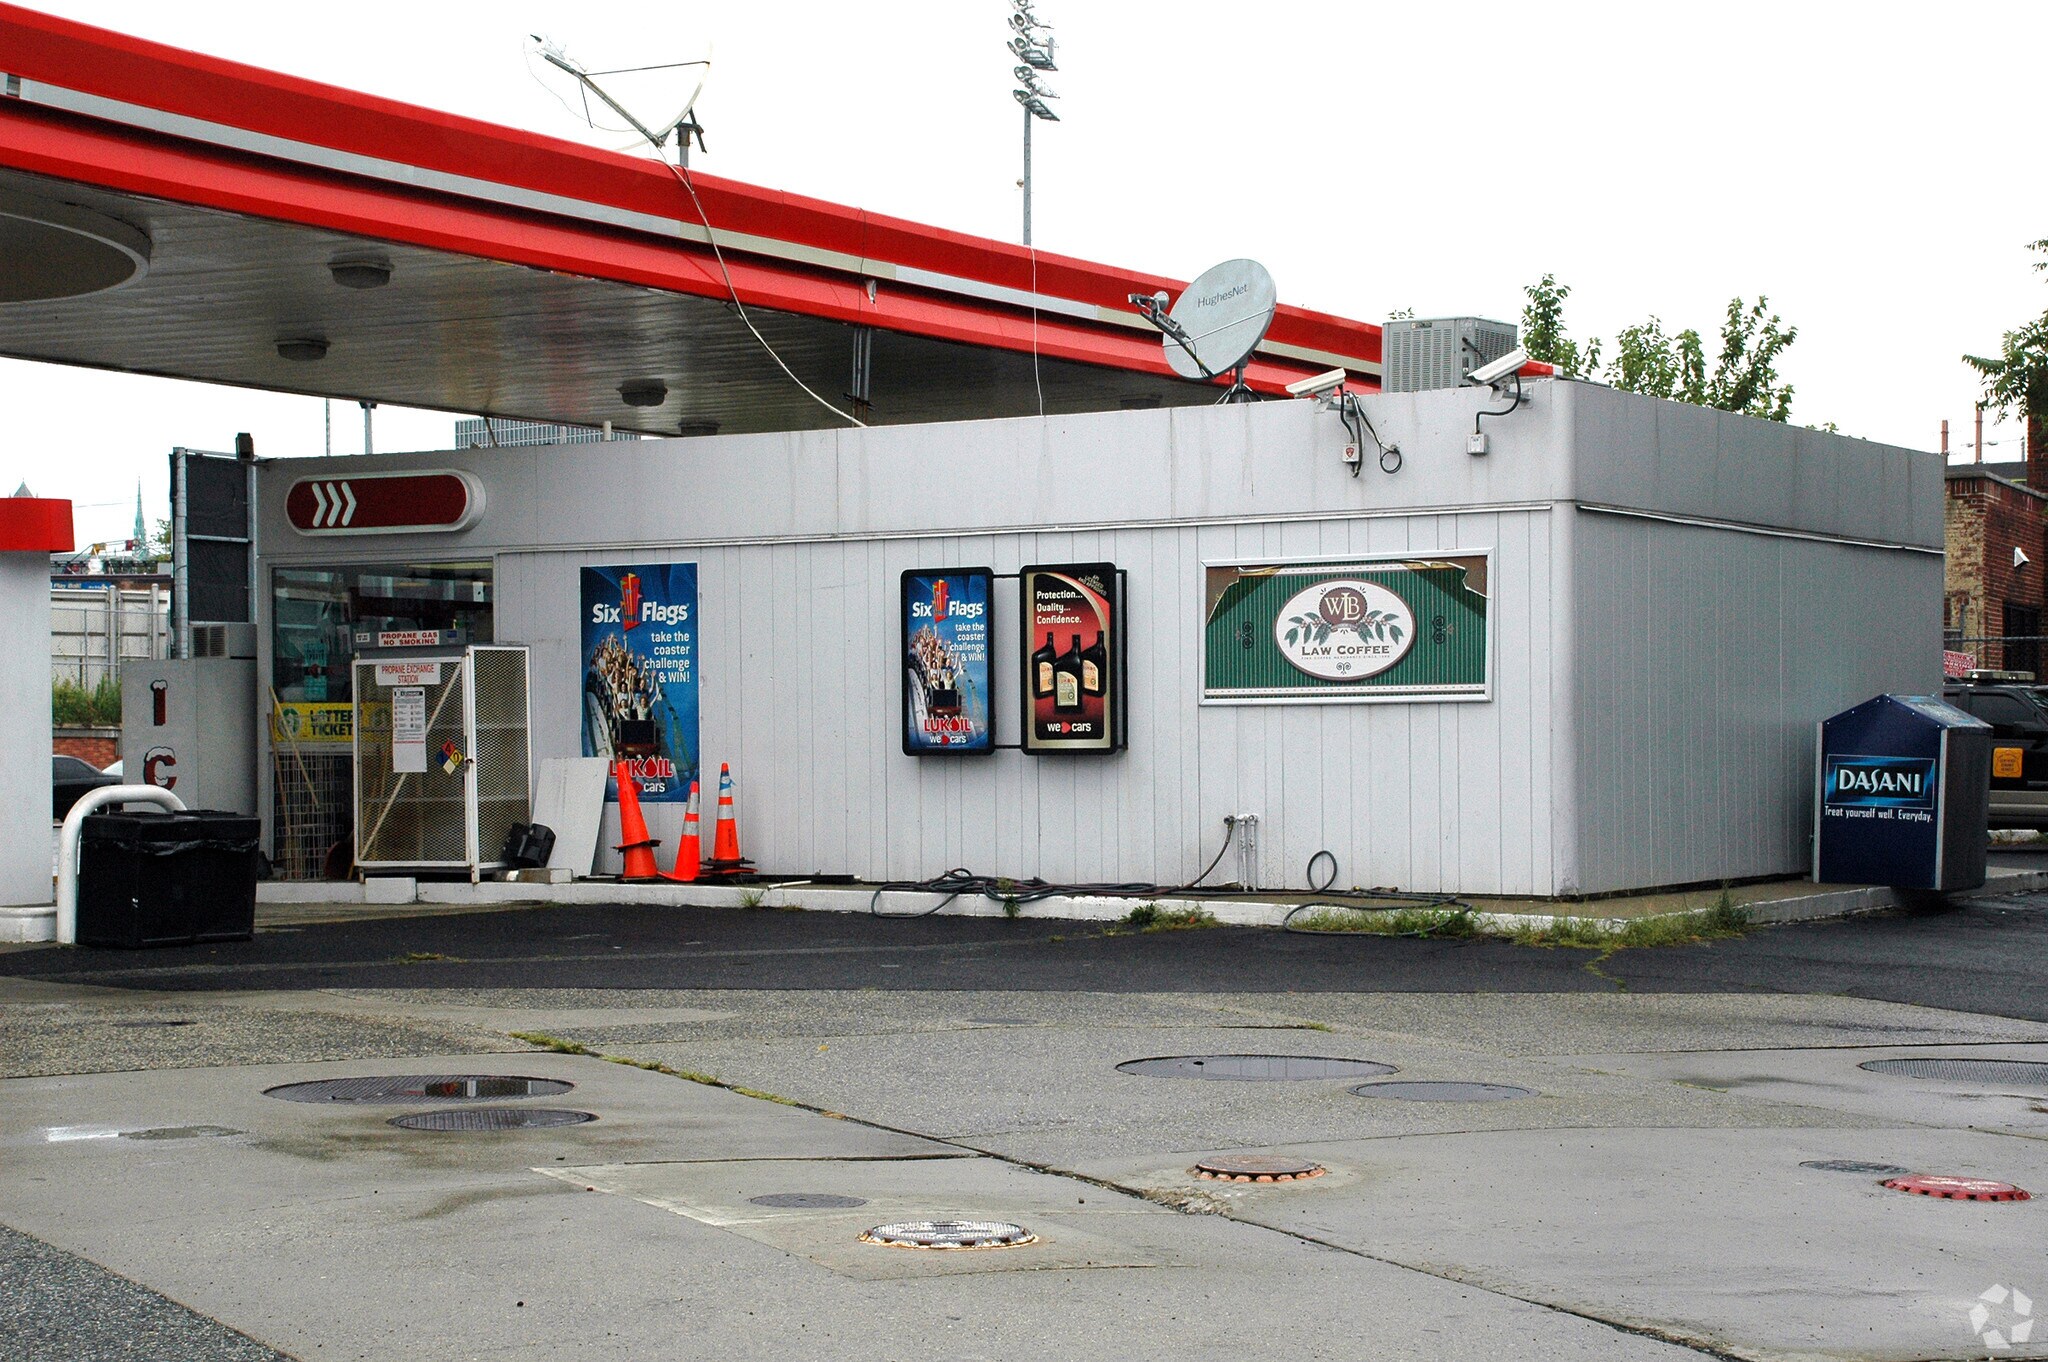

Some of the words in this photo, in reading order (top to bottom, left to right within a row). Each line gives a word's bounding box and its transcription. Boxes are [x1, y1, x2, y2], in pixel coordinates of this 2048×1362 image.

[1197, 284, 1248, 308] HughesNet
[1036, 590, 1082, 600] Protection...
[592, 603, 620, 623] Six
[642, 601, 688, 626] Flags
[912, 601, 932, 617] Six
[948, 600, 983, 618] Flags
[1036, 615, 1082, 624] Confidence.
[955, 623, 971, 631] take
[972, 622, 985, 631] the
[651, 631, 672, 642] take
[674, 631, 690, 642] the
[654, 645, 690, 655] coaster
[950, 643, 985, 653] challenge
[961, 653, 968, 662] &
[968, 652, 985, 661] WIN!
[381, 665, 406, 674] PROPANE
[406, 664, 434, 673] EXCHANGE
[644, 658, 690, 672] challenge
[398, 675, 418, 684] STATION
[658, 672, 666, 683] &
[668, 672, 690, 683] WIN!
[310, 709, 353, 722] LOTTER
[1047, 723, 1061, 732] we
[1071, 722, 1092, 732] cars
[950, 735, 966, 743] cars
[445, 743, 451, 753] 4
[1839, 769, 1920, 793] DASANI
[644, 782, 666, 792] cars
[1824, 805, 1843, 817] Treat
[1845, 807, 1875, 819] yourself
[1878, 809, 1894, 819] well.
[1898, 809, 1933, 823] Everyday.
